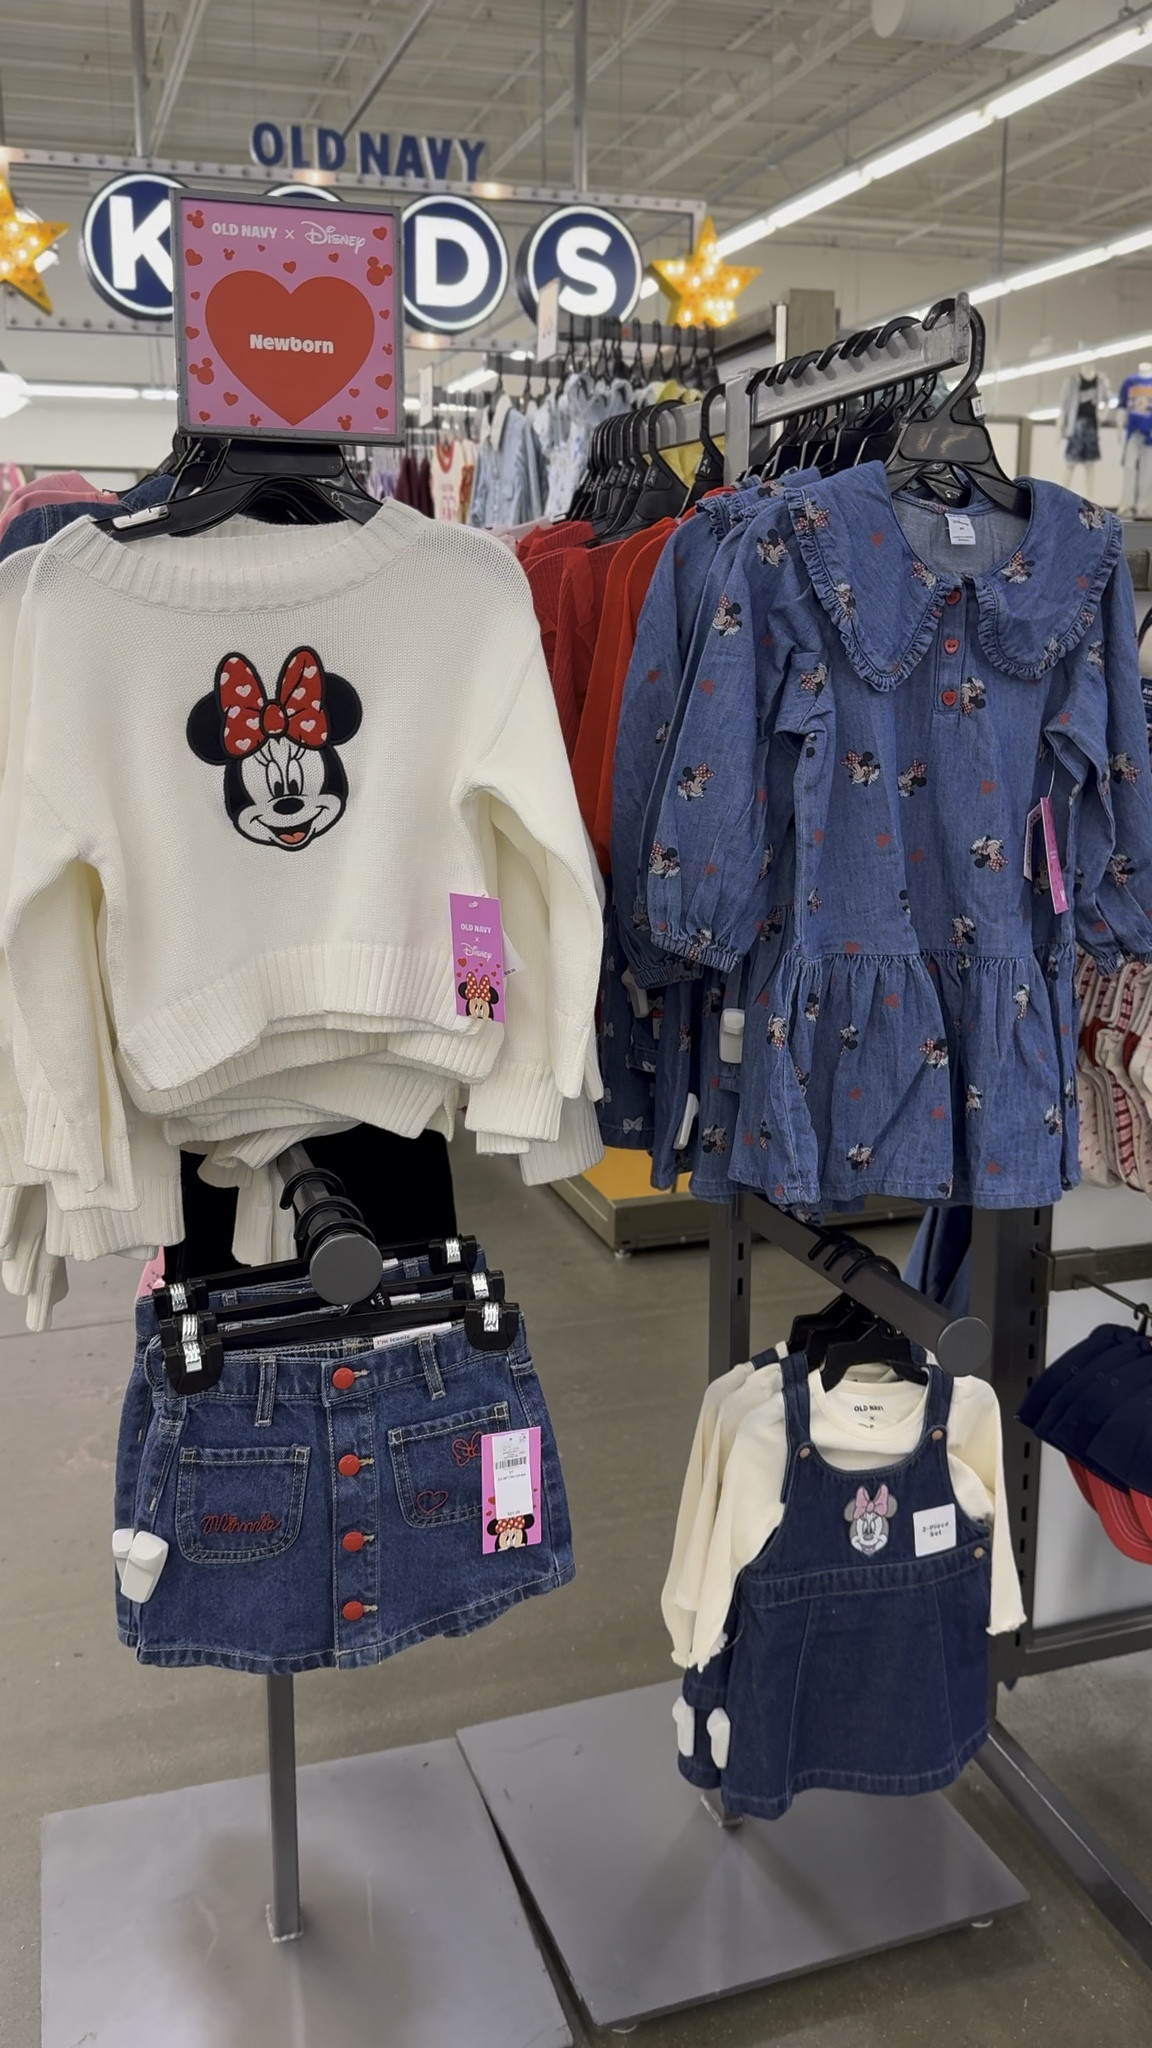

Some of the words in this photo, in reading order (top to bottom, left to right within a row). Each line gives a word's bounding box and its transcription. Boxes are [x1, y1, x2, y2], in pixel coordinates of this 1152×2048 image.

[252, 122, 347, 171] OLD
[356, 131, 486, 182] NAVY
[211, 222, 239, 236] OLD
[241, 225, 277, 239] NAVY
[249, 334, 334, 354] Newborn
[460, 923, 474, 932] OLD
[474, 925, 492, 934] NAVY
[201, 1513, 282, 1536] Minnie
